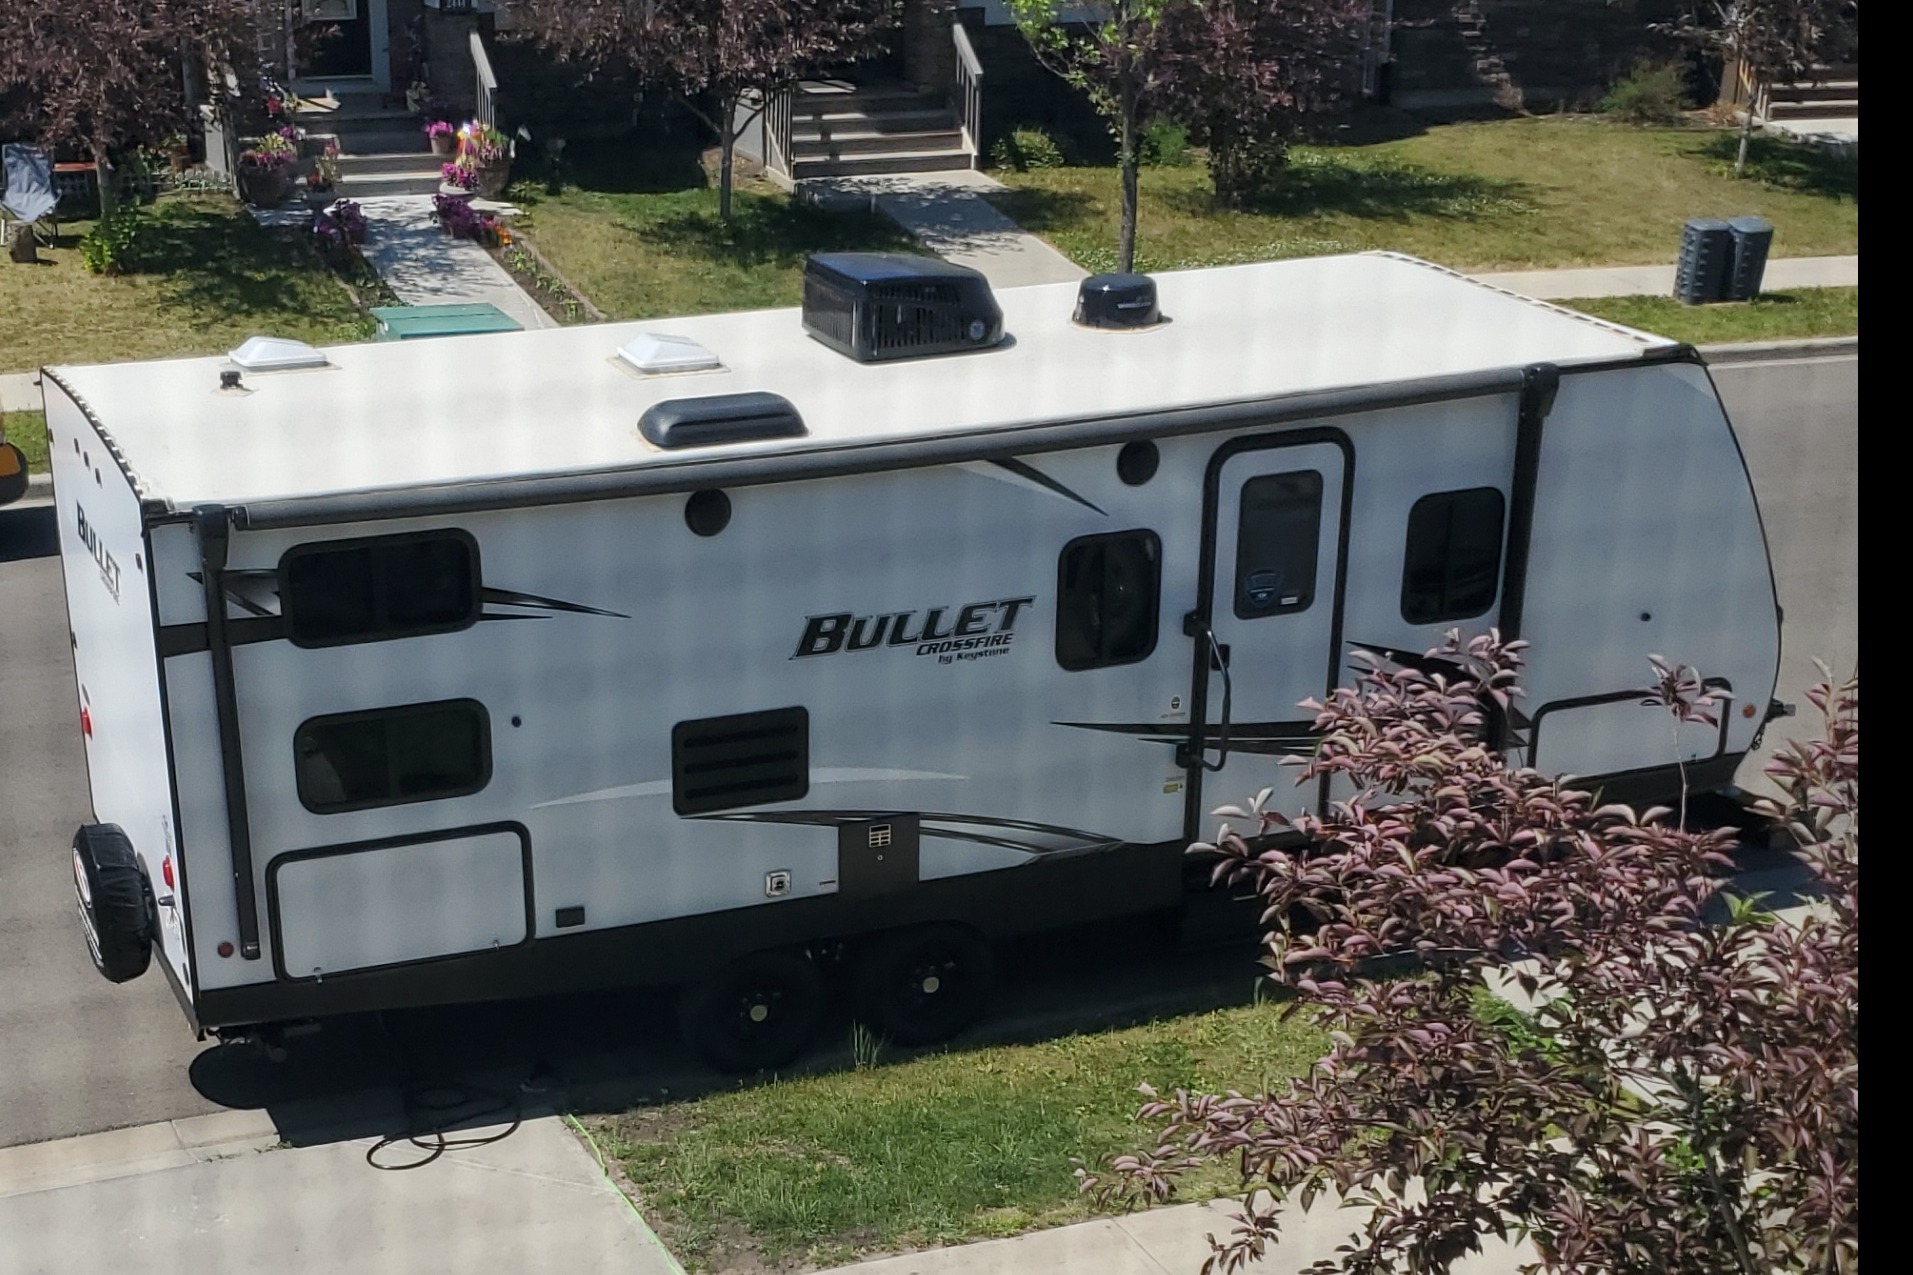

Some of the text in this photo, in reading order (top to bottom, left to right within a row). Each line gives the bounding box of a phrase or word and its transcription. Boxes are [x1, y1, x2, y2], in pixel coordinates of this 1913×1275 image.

[76, 499, 121, 594] BULLET
[788, 595, 1037, 660] BULLET
[916, 633, 1014, 656] CROSSFIRE
[938, 647, 1010, 665] by Keystone
